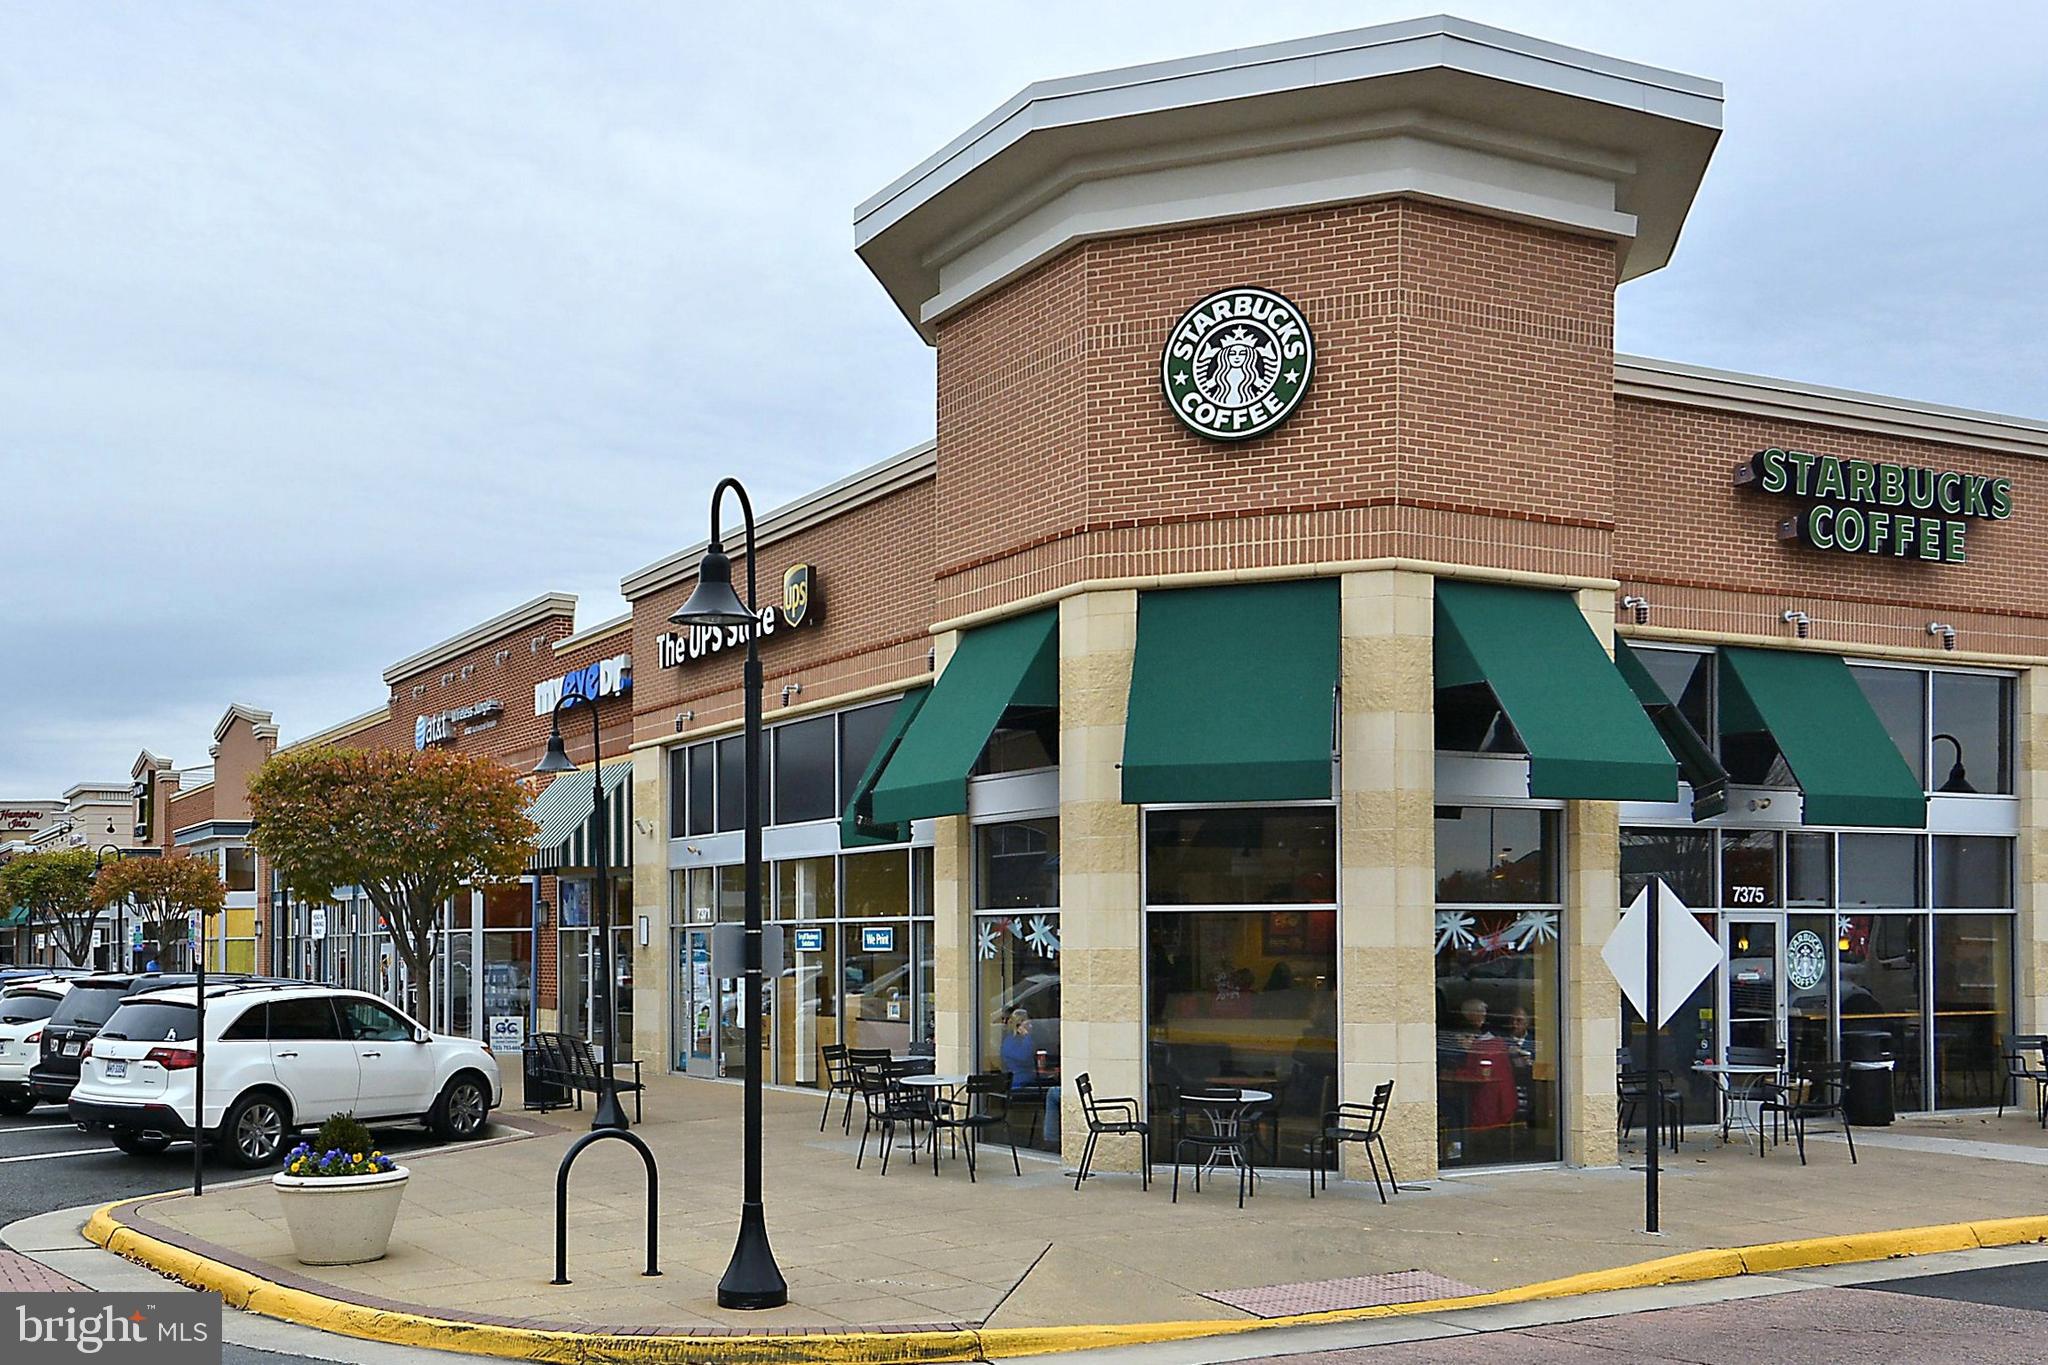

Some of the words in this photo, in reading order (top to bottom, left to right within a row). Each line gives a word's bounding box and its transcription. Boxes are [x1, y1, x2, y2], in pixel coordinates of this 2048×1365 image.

[1173, 296, 1305, 361] STARBUCKS
[1181, 392, 1284, 430] COFFEE
[1762, 448, 2013, 520] STARBUCKS
[1808, 505, 1967, 563] COFFEE
[785, 581, 807, 618] ups
[656, 632, 686, 669] The
[689, 624, 723, 659] UPS
[726, 606, 775, 648] Stre
[425, 713, 447, 744] at&t
[0, 809, 43, 820] Hampton
[8, 819, 31, 830] Inn
[1732, 886, 1765, 903] 7375
[866, 933, 875, 945] We
[876, 933, 889, 945] Print
[1788, 933, 1824, 959] STARBUCKS
[1791, 971, 1818, 986] COFFEE
